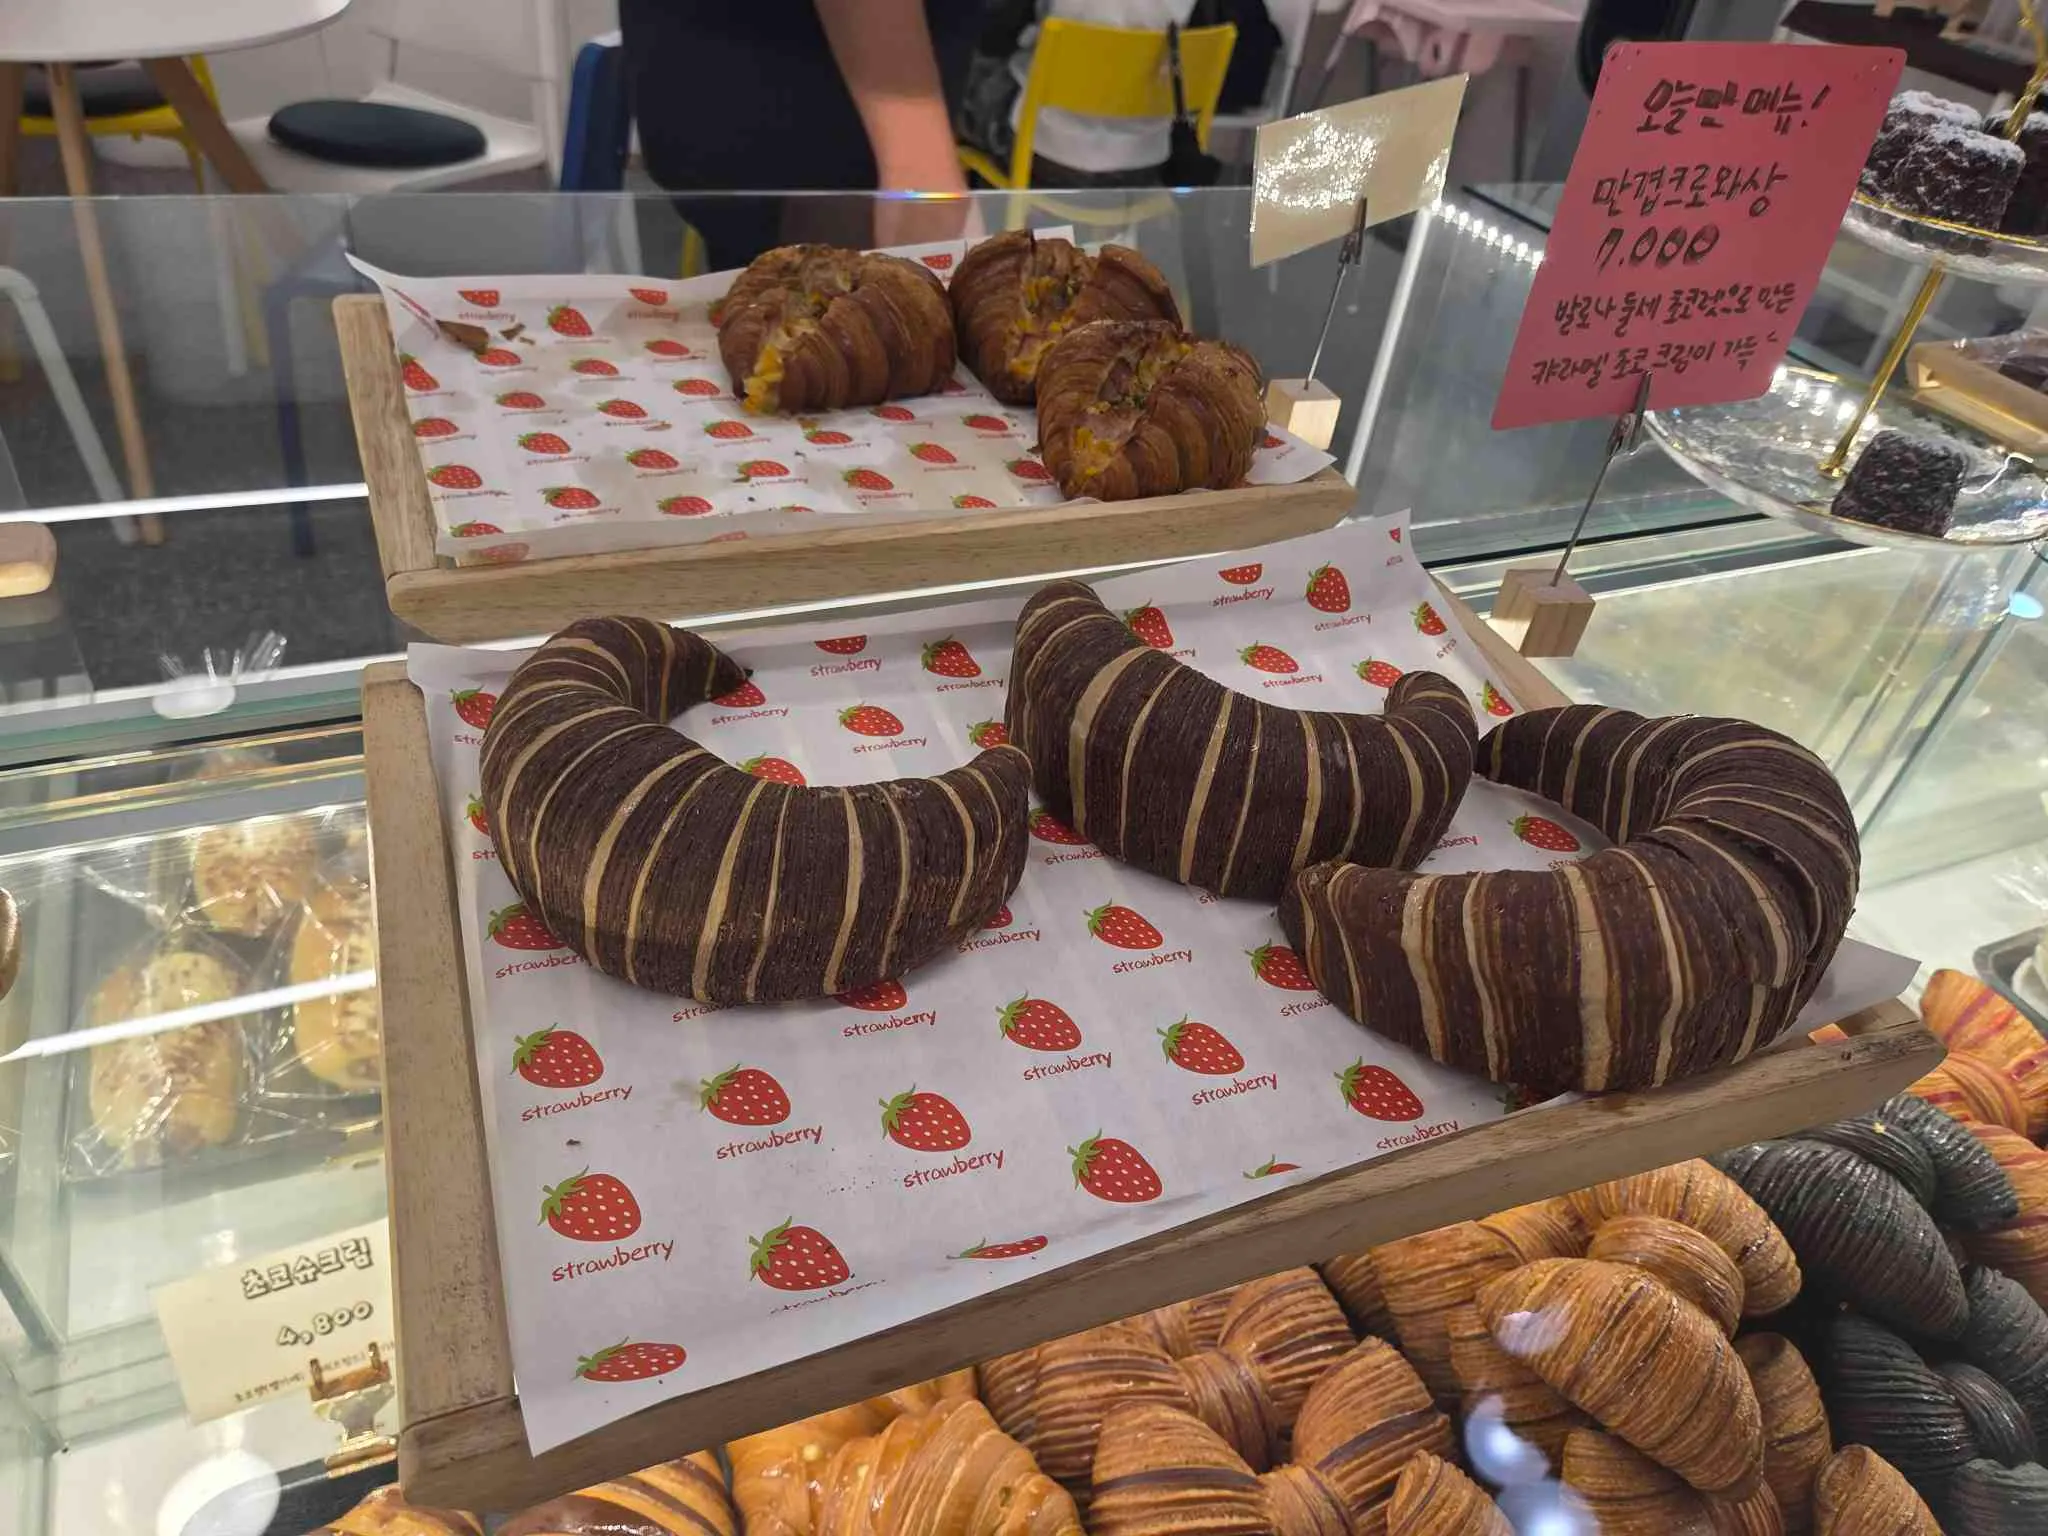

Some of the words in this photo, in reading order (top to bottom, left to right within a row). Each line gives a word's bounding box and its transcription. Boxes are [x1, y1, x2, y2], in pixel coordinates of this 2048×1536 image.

[1212, 587, 1275, 607] strawberry
[1314, 614, 1372, 632] strawberry
[811, 657, 883, 678] strawberry
[1263, 674, 1323, 688] strawberry
[936, 678, 1004, 693] strawberry
[711, 706, 789, 726] strawberry
[853, 736, 927, 754] strawberry
[957, 929, 1041, 954] strawberry
[1112, 949, 1193, 975] strawberry
[843, 1010, 937, 1038] strawberry
[1023, 1051, 1113, 1081] strawberry
[521, 1084, 633, 1122] strawberry
[1191, 1073, 1278, 1106] strawberry
[716, 1125, 823, 1160] strawberry
[1376, 1120, 1459, 1149] strawberry
[903, 1149, 1005, 1188] strawberry
[240, 1237, 374, 1300] 초코슈크림
[551, 1239, 675, 1282] strawberry
[276, 1301, 374, 1346] 4,800
